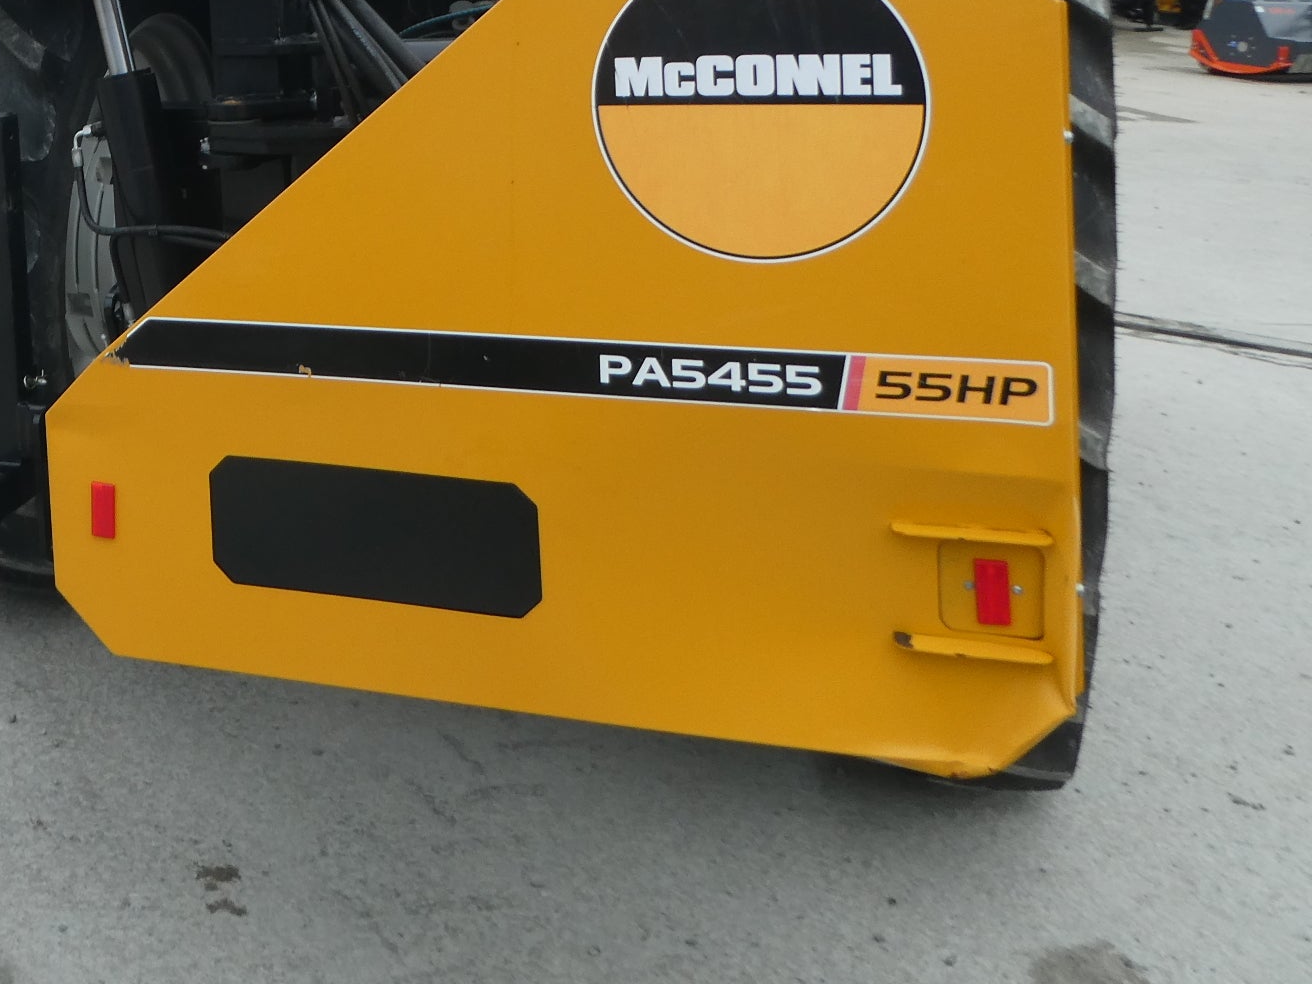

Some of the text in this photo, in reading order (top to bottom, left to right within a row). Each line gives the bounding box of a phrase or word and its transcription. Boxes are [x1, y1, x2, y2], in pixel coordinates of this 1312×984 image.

[614, 54, 903, 98] McCONNEL
[599, 354, 1038, 406] PA5455 55HP
